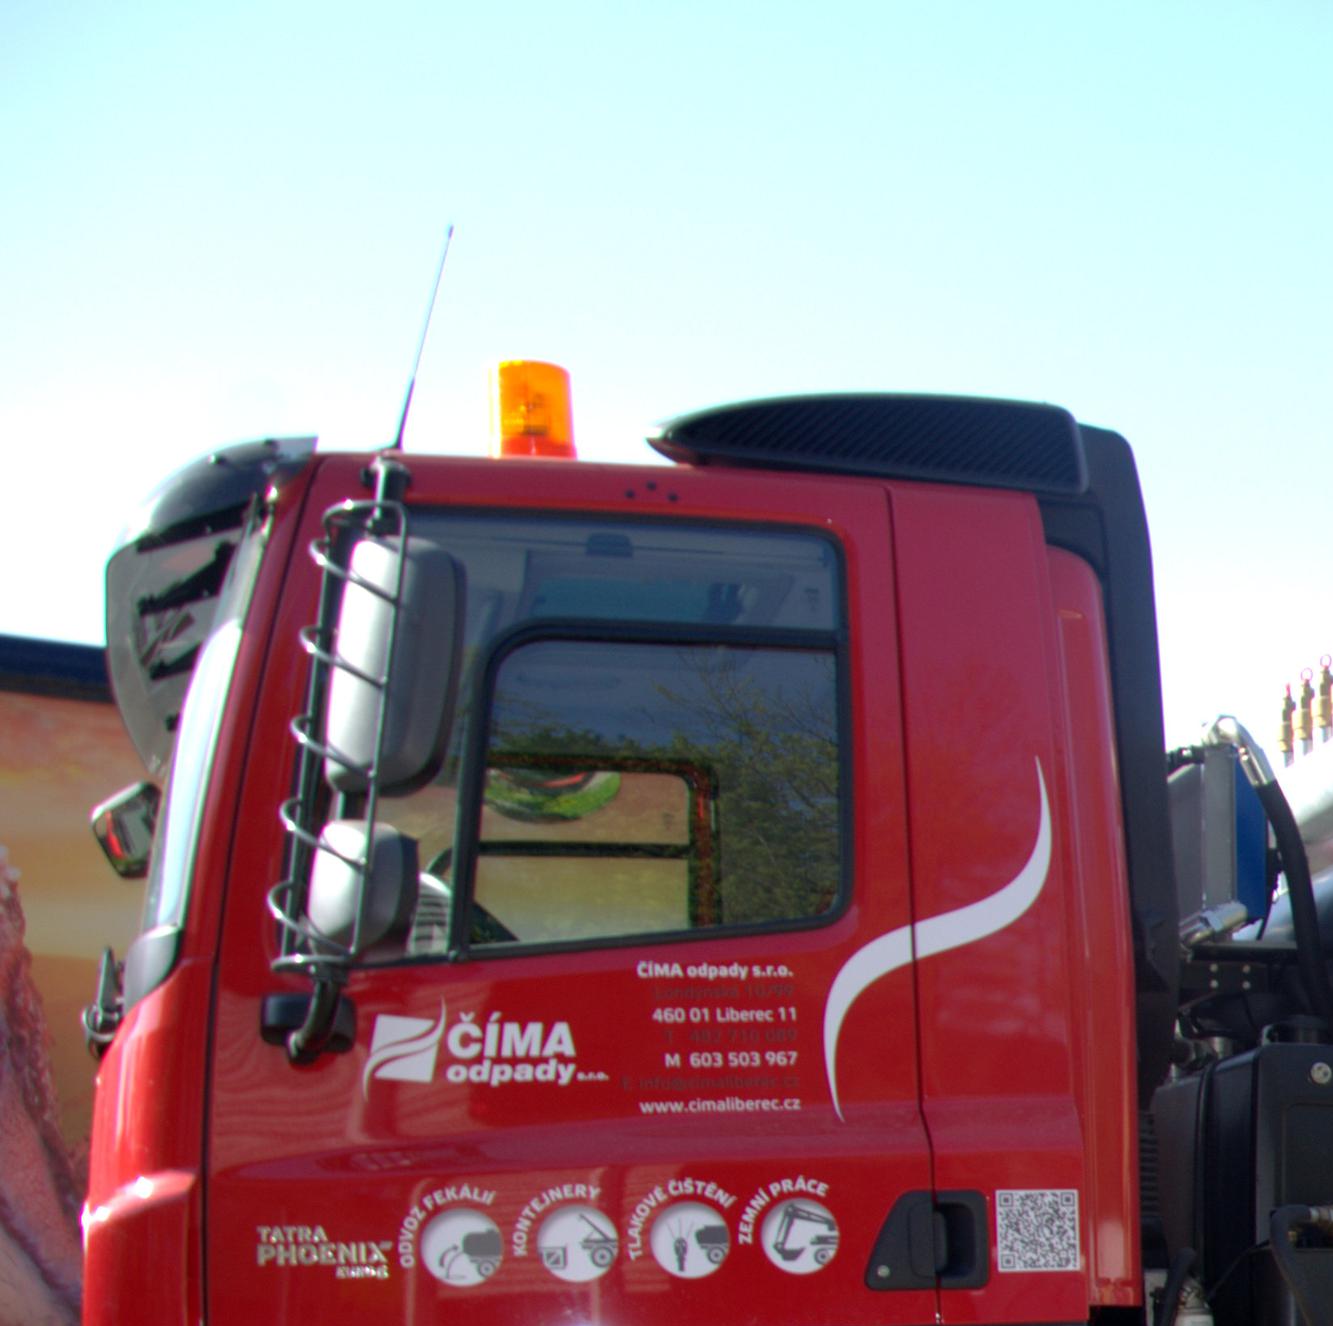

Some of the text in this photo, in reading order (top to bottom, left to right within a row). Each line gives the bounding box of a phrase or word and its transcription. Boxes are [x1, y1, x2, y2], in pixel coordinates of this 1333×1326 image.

[636, 960, 795, 981] ČÍMA odpady s.r.o.
[652, 1006, 797, 1024] 460 01 Liberec 11
[446, 1011, 577, 1059] ČÍMA
[446, 1058, 577, 1087] odpady
[664, 1050, 798, 1069] M 603 503 967
[639, 1096, 801, 1114] www.cimaliberec.cz
[512, 1183, 602, 1257] KONTEJNERY
[627, 1176, 738, 1261] TLAKOVÉ ČIŠTĚNÍ
[738, 1174, 830, 1245] ZEMNÍ PRÁCE
[256, 1225, 328, 1243] TATRA
[398, 1205, 427, 1269] ODVOZ
[256, 1241, 392, 1266] PHOENIX
